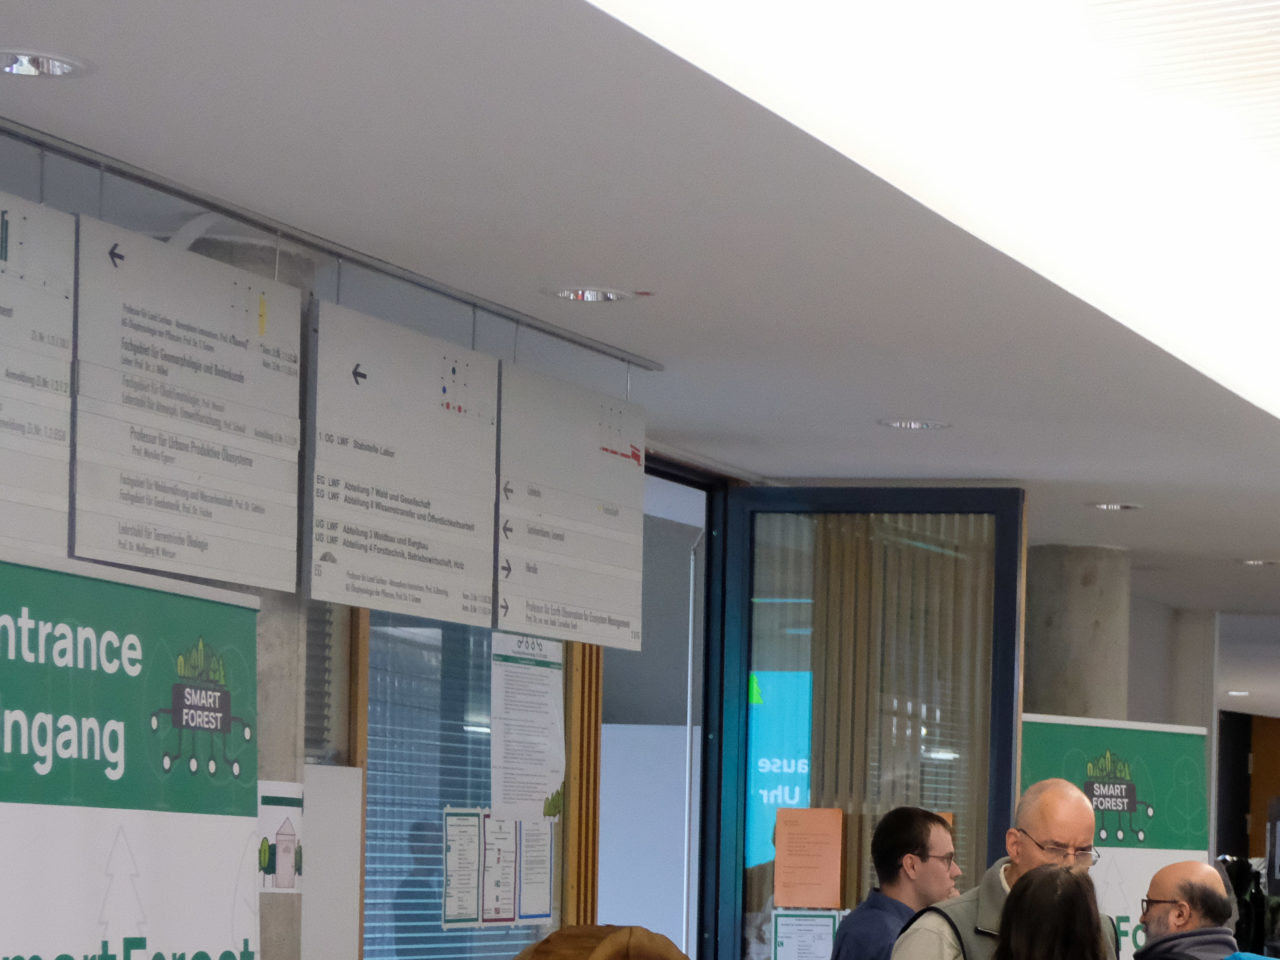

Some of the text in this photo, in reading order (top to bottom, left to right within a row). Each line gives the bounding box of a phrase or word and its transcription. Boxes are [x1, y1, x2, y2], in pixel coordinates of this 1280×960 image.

[345, 482, 369, 497] Abteilung
[344, 496, 369, 510] Abteilung
[343, 525, 368, 540] Abteilung
[343, 539, 368, 553] Abteilung
[0, 607, 143, 676] ntrance
[184, 688, 221, 709] SMART
[182, 709, 223, 730] FOREST
[3, 709, 126, 781] ngang
[1093, 784, 1126, 796] SMART
[1092, 797, 1128, 810] FOREST
